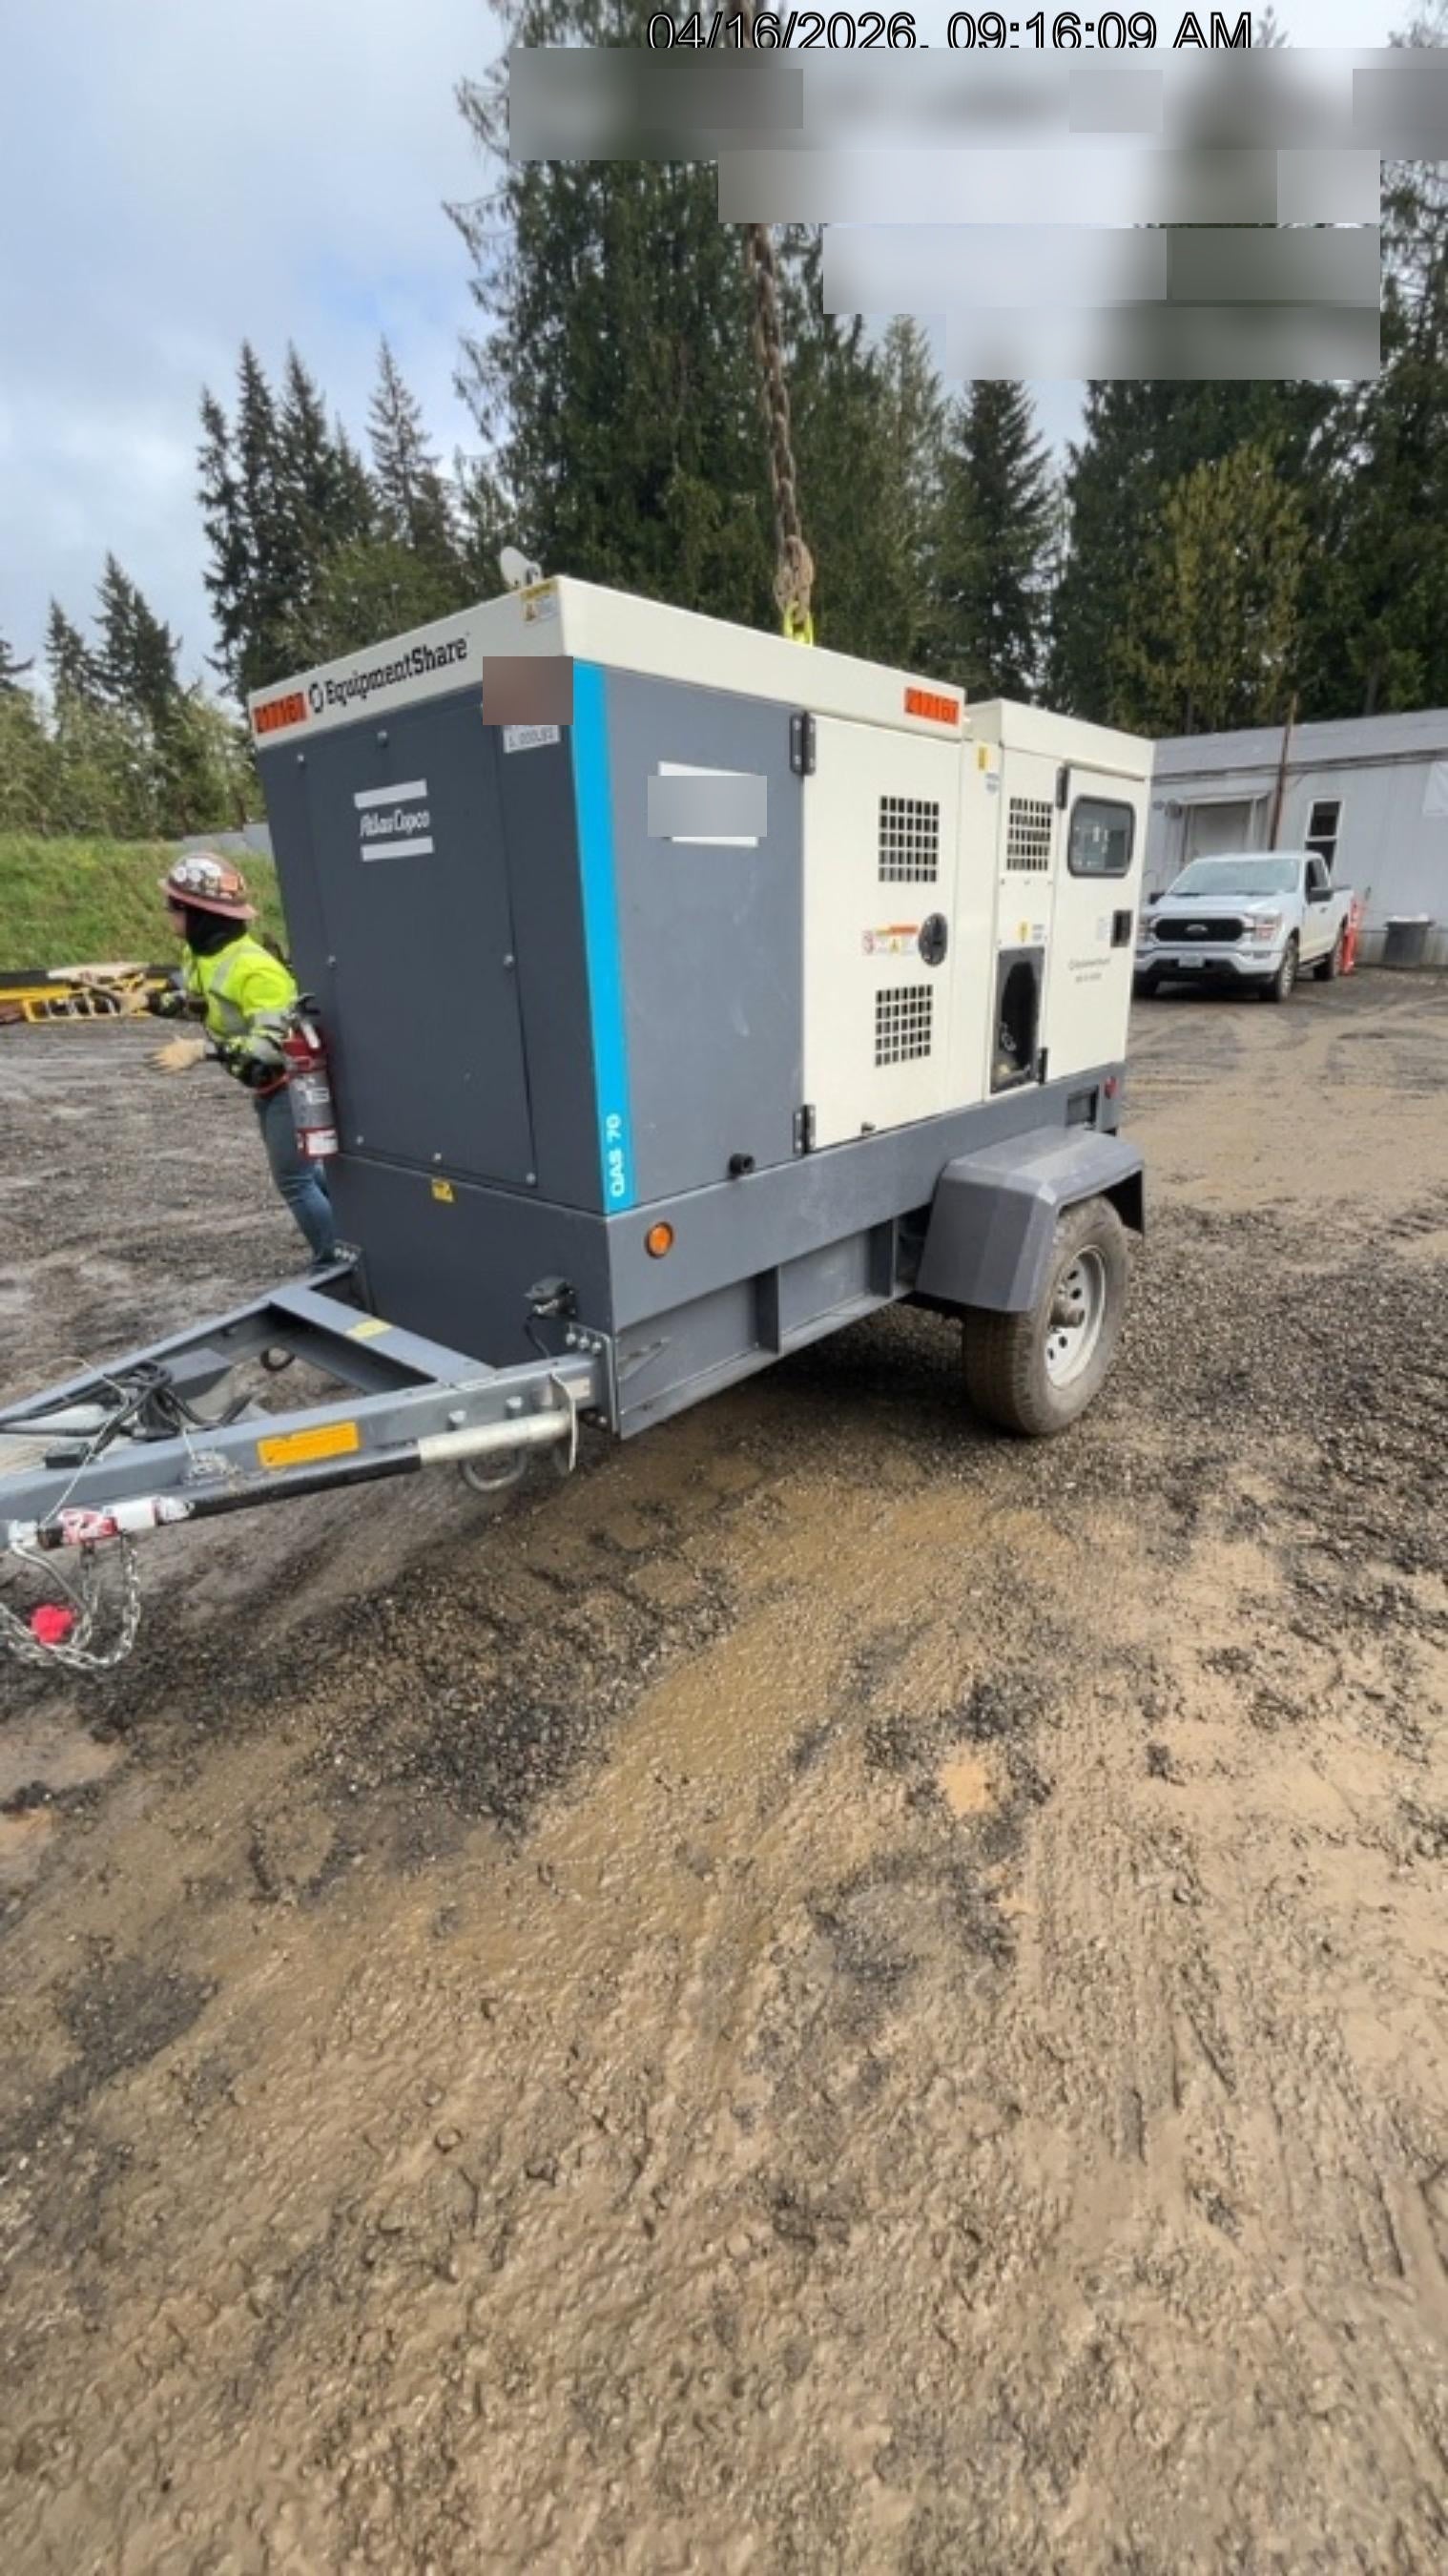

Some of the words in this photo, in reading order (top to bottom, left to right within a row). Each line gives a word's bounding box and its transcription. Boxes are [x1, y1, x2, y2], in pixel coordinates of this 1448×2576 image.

[325, 637, 467, 706] EquipmentShare
[606, 1112, 622, 1143] 70
[609, 1148, 625, 1197] QAS
